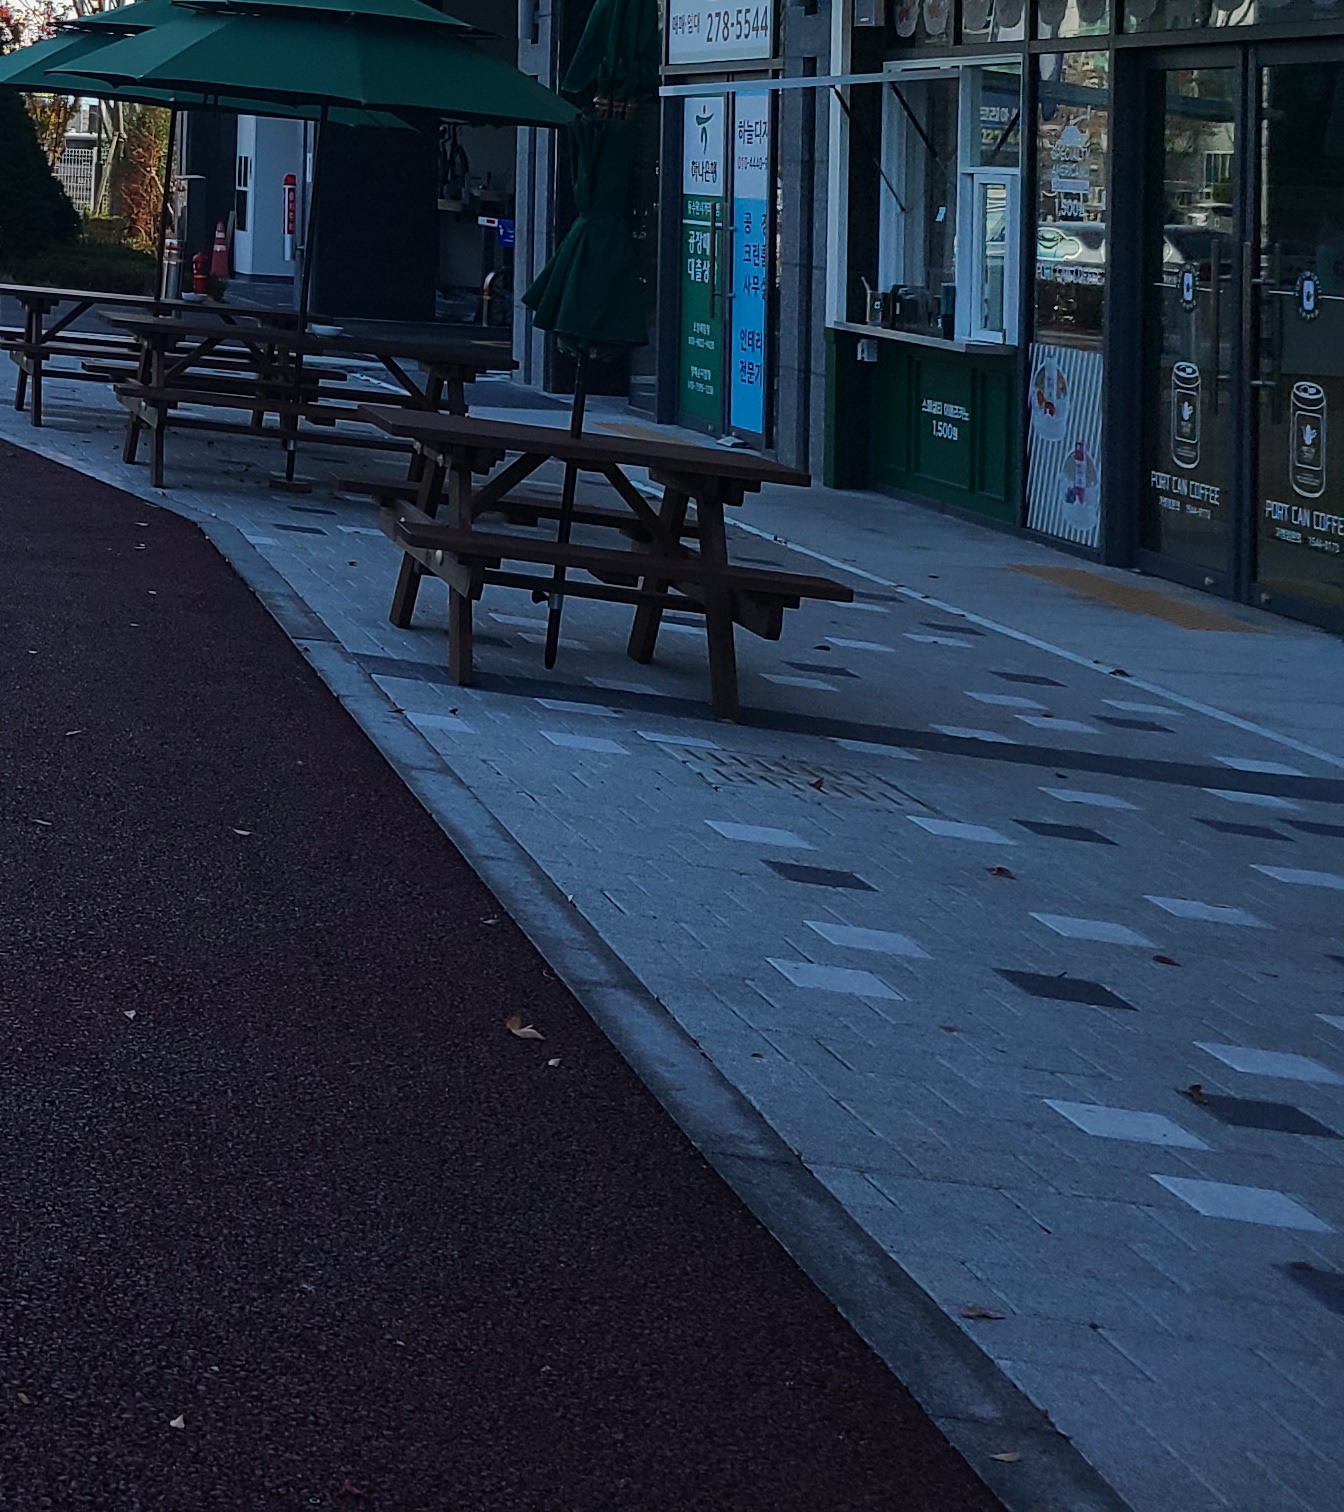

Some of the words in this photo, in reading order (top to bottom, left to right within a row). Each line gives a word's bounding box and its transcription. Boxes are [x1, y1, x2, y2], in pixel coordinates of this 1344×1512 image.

[690, 160, 718, 185] 하나은행
[687, 230, 718, 257] 공장매
[687, 257, 718, 285] 대출상
[1151, 470, 1171, 490] PORT
[1172, 477, 1188, 496] CAN
[1189, 480, 1220, 506] COFFEE
[1265, 499, 1290, 522] PORT
[1292, 506, 1310, 527] CAN
